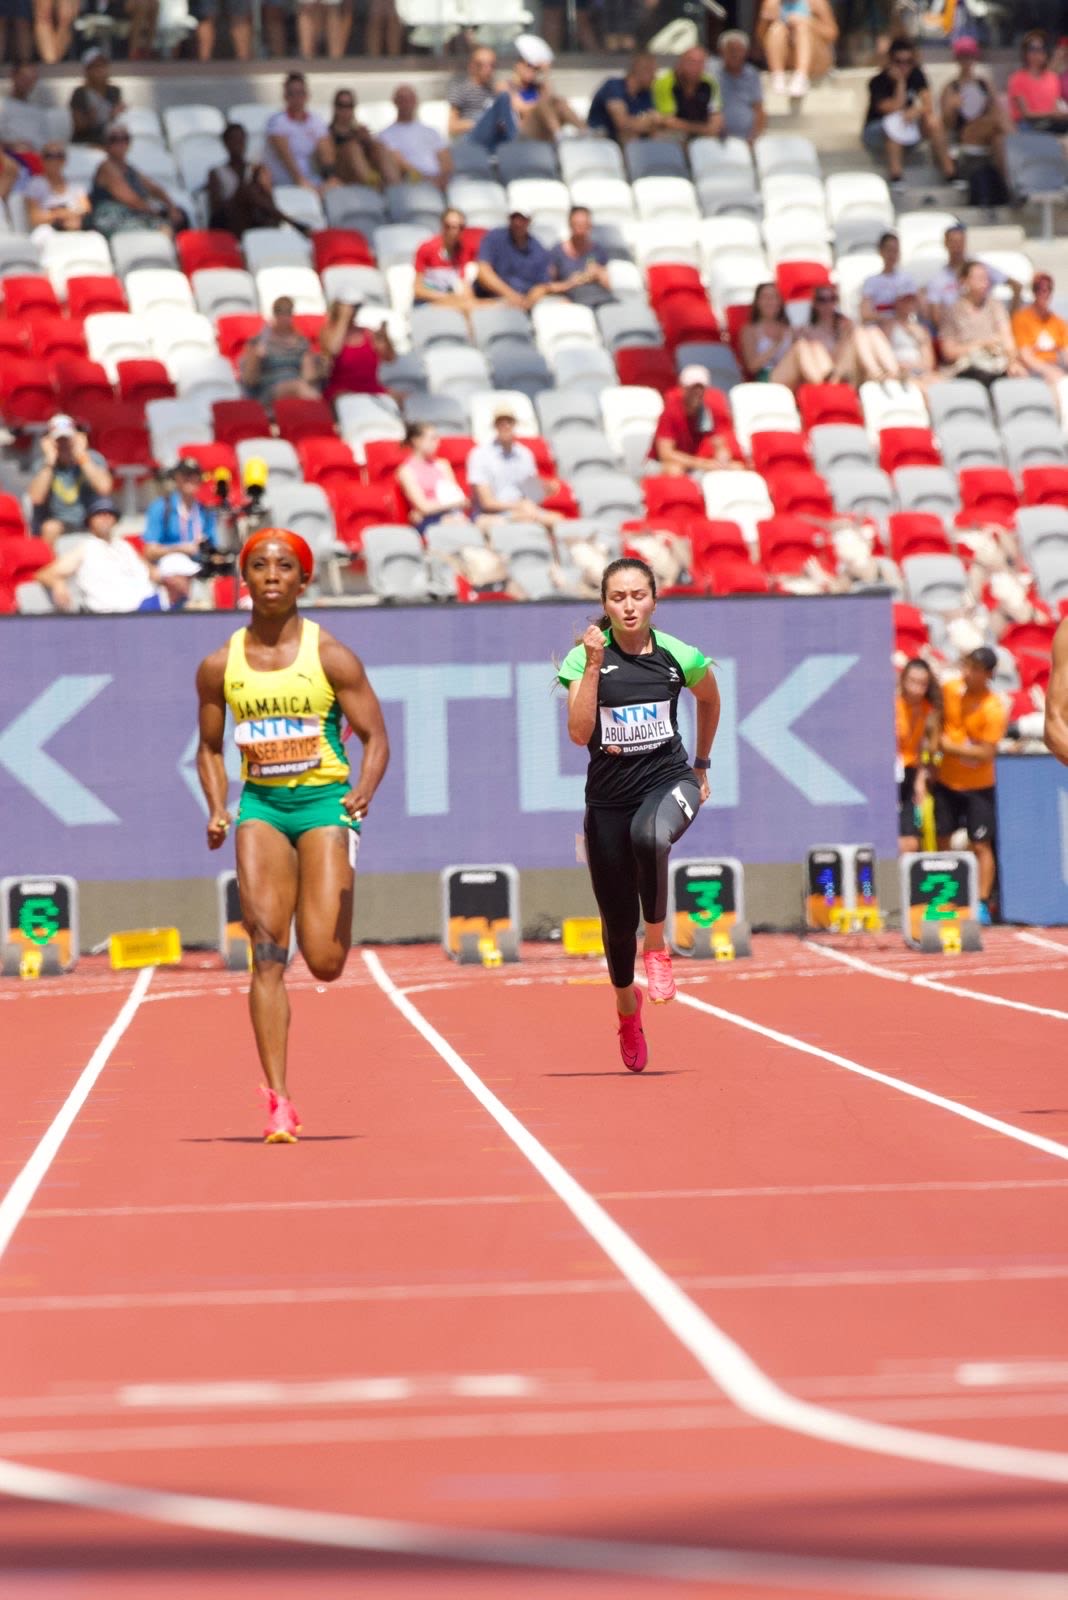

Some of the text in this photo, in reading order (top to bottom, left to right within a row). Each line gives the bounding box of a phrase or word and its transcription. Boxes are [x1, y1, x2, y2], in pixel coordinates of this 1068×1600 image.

[237, 696, 312, 719] JAMAICA
[611, 703, 658, 724] NTN
[248, 716, 304, 739] NTN
[604, 720, 670, 742] ABULJADAYEL
[242, 737, 318, 761] SER-PRYCE
[622, 742, 662, 753] BUDAPEST
[686, 880, 724, 929] 3
[919, 873, 960, 922] 2
[19, 896, 61, 945] 6
